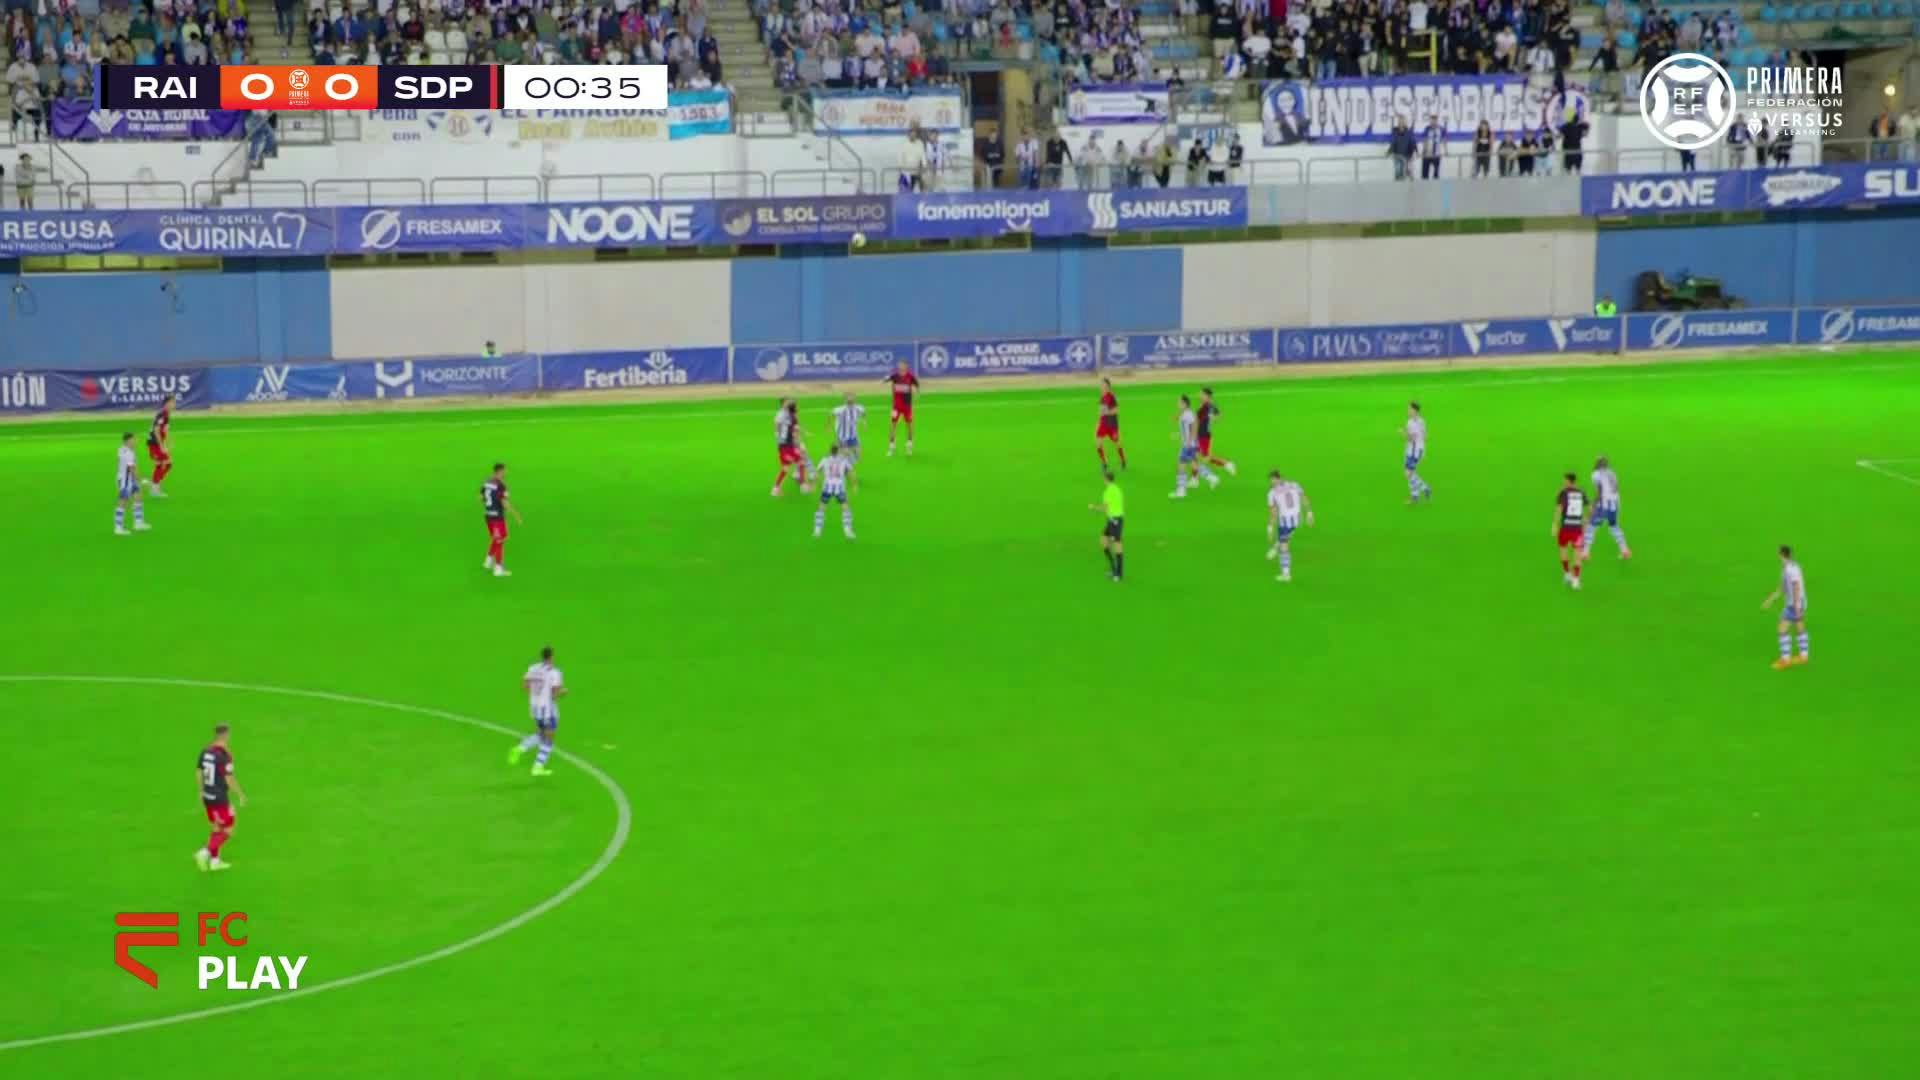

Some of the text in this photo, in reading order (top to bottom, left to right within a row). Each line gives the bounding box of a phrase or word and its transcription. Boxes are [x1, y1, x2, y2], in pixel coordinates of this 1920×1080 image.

[1309, 83, 1543, 137] INDESEABLES
[1610, 178, 1718, 209] NOONE
[757, 204, 886, 223] EL SOL GRUPO
[917, 199, 1050, 221] fanemotional
[1120, 199, 1230, 218] SANIASTUR
[218, 214, 265, 225] DENTAL
[406, 219, 503, 236] FRESAMEX
[548, 205, 694, 243] NOONE
[4, 220, 114, 240] RECUSA
[159, 226, 292, 251] QUIRINAL
[1688, 320, 1768, 336] FRESAMEX
[975, 344, 995, 356] LA
[1155, 333, 1251, 350] ASESORES
[813, 352, 841, 364] SOL
[955, 353, 1061, 369] DE ASTURIAS
[420, 366, 508, 382] HORIZONTE
[584, 364, 688, 389] Fertiberia
[101, 375, 191, 394] VERSUS
